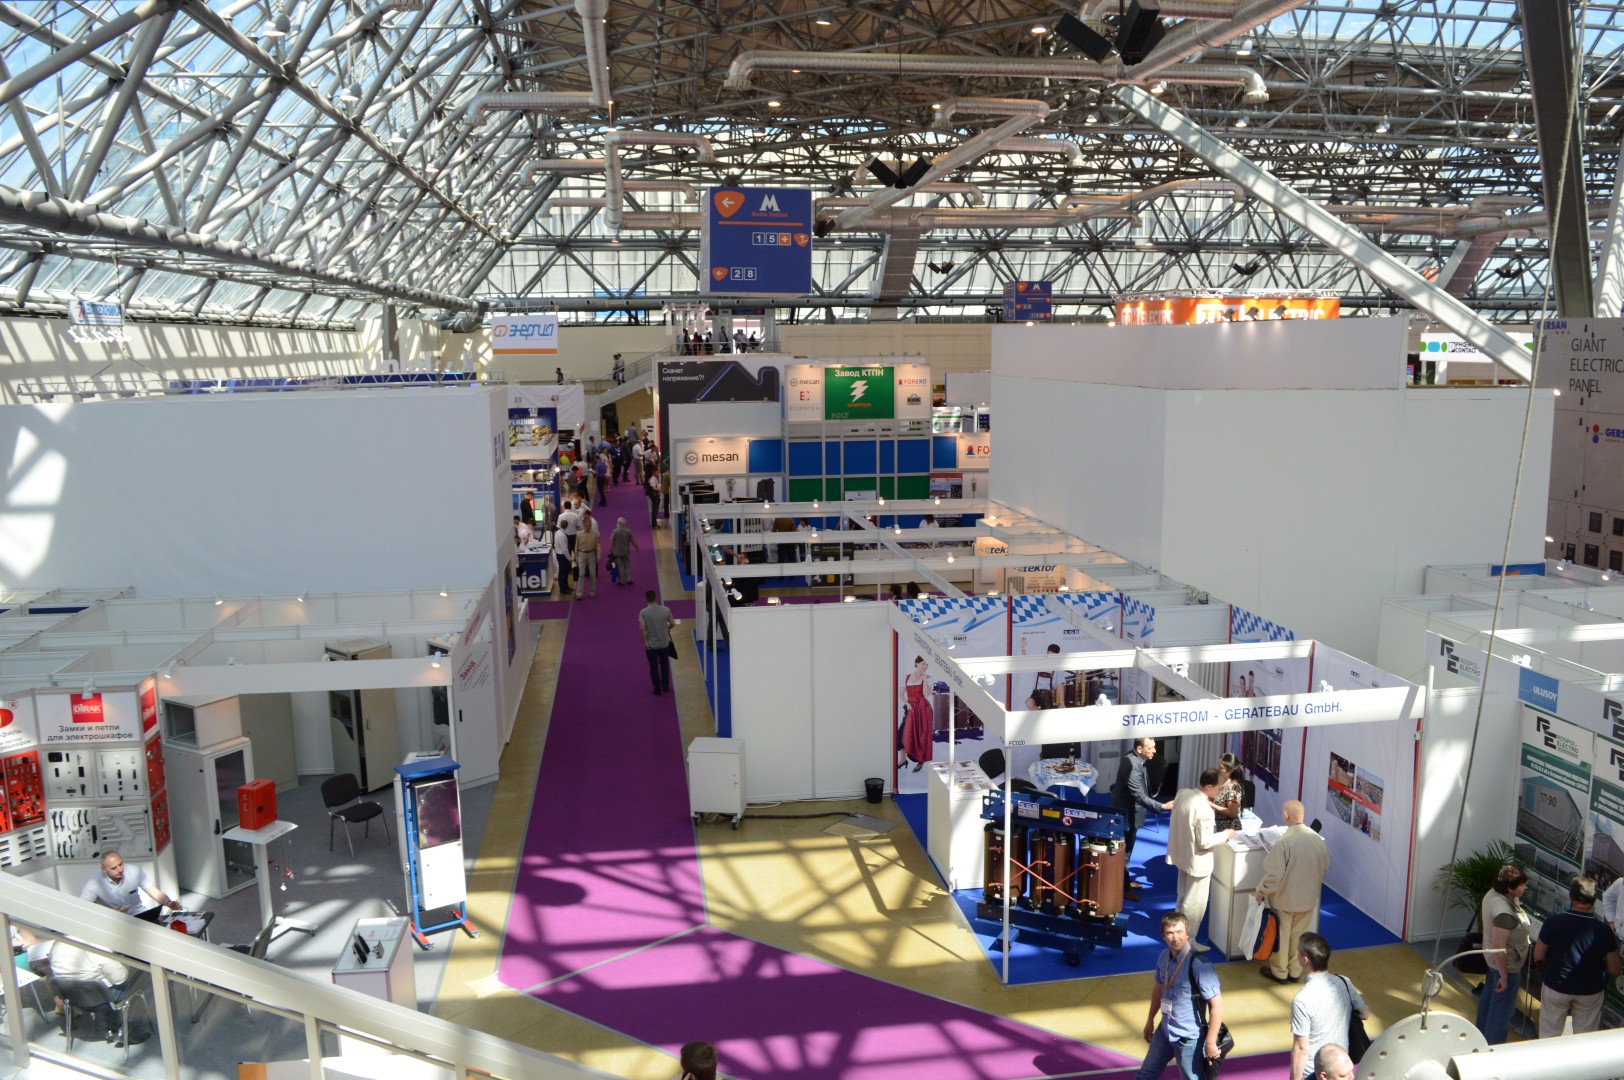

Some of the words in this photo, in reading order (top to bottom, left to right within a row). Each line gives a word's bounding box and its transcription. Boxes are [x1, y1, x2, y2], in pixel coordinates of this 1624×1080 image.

[1571, 339, 1607, 352] GIANT
[1570, 358, 1624, 373] ELECTRIC
[834, 369, 860, 377] Завод
[1569, 379, 1602, 393] PANEL
[702, 453, 739, 462] mesan
[990, 546, 1008, 554] tek
[1533, 685, 1557, 700] ULUSOY
[1122, 711, 1208, 727] STARKSTROM
[1224, 704, 1299, 720] GERATEBAU
[1304, 702, 1342, 715] GmbH.
[66, 732, 134, 741] электрошкафов
[1556, 741, 1579, 754] ELECTRO
